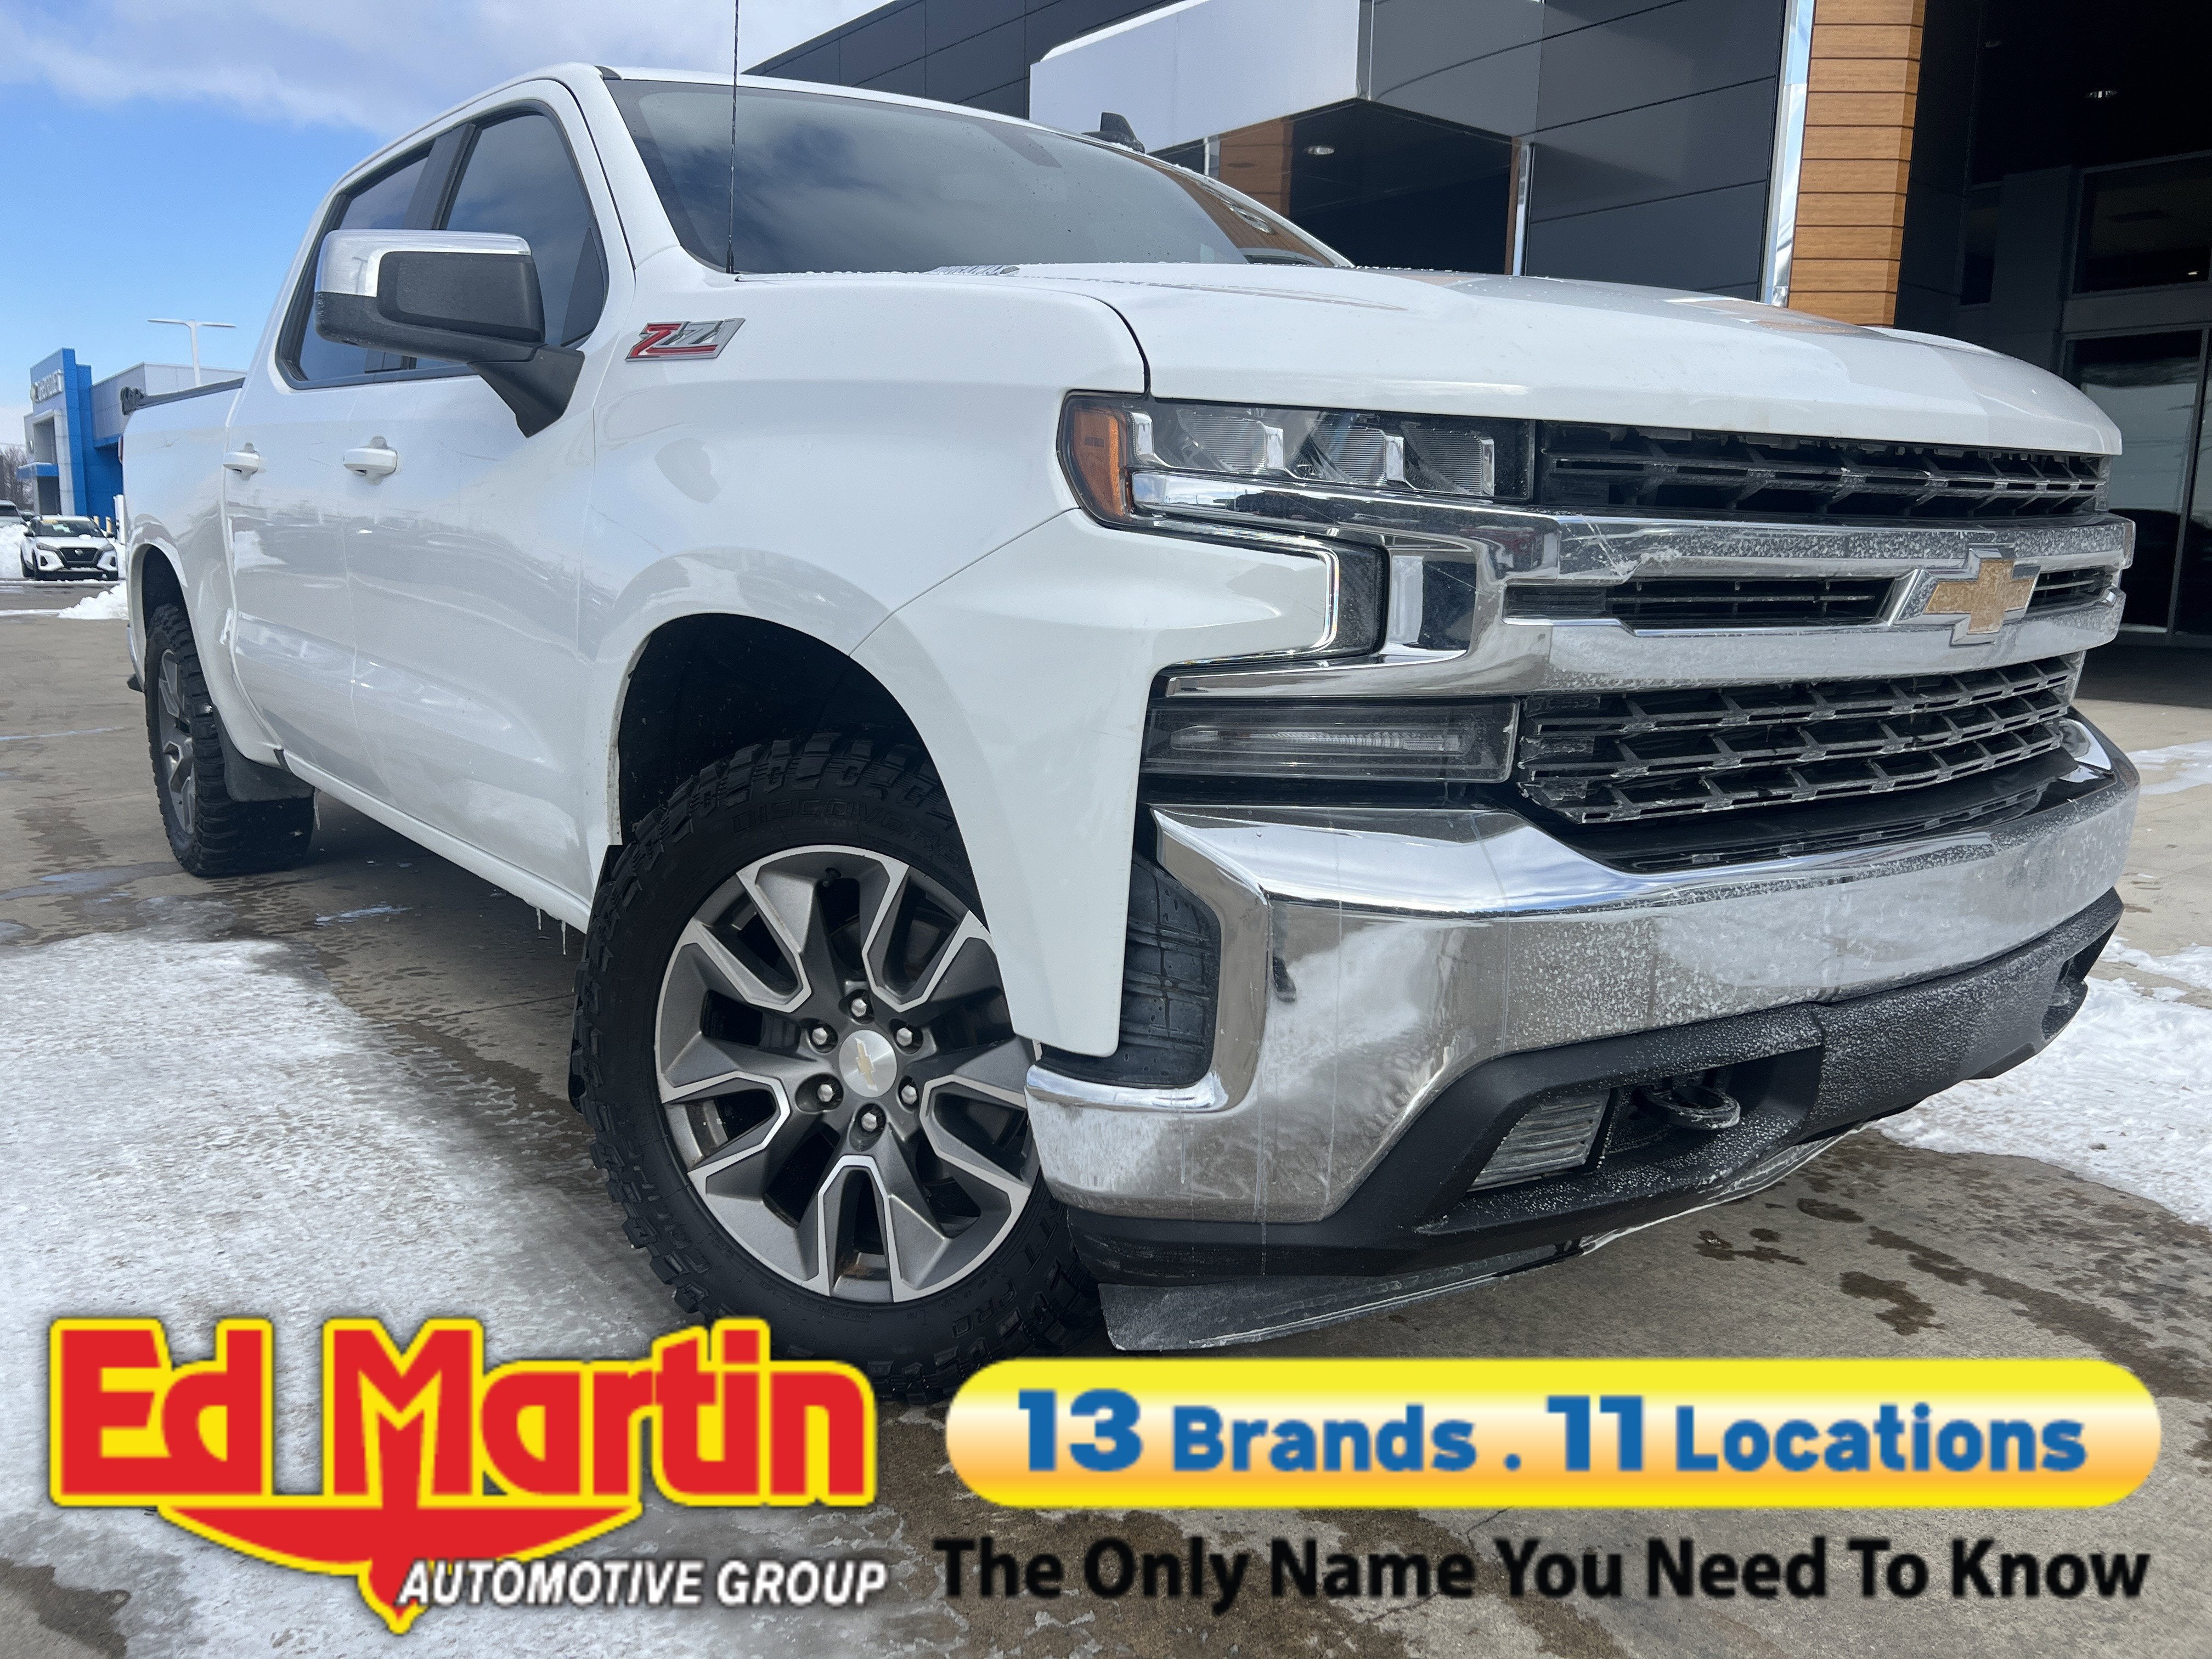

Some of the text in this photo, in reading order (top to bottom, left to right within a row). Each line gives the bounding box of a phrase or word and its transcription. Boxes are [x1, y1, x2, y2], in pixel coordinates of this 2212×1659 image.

[624, 318, 746, 362] Z71
[731, 797, 973, 879] DISCOVERE
[952, 1283, 1018, 1339] PRO
